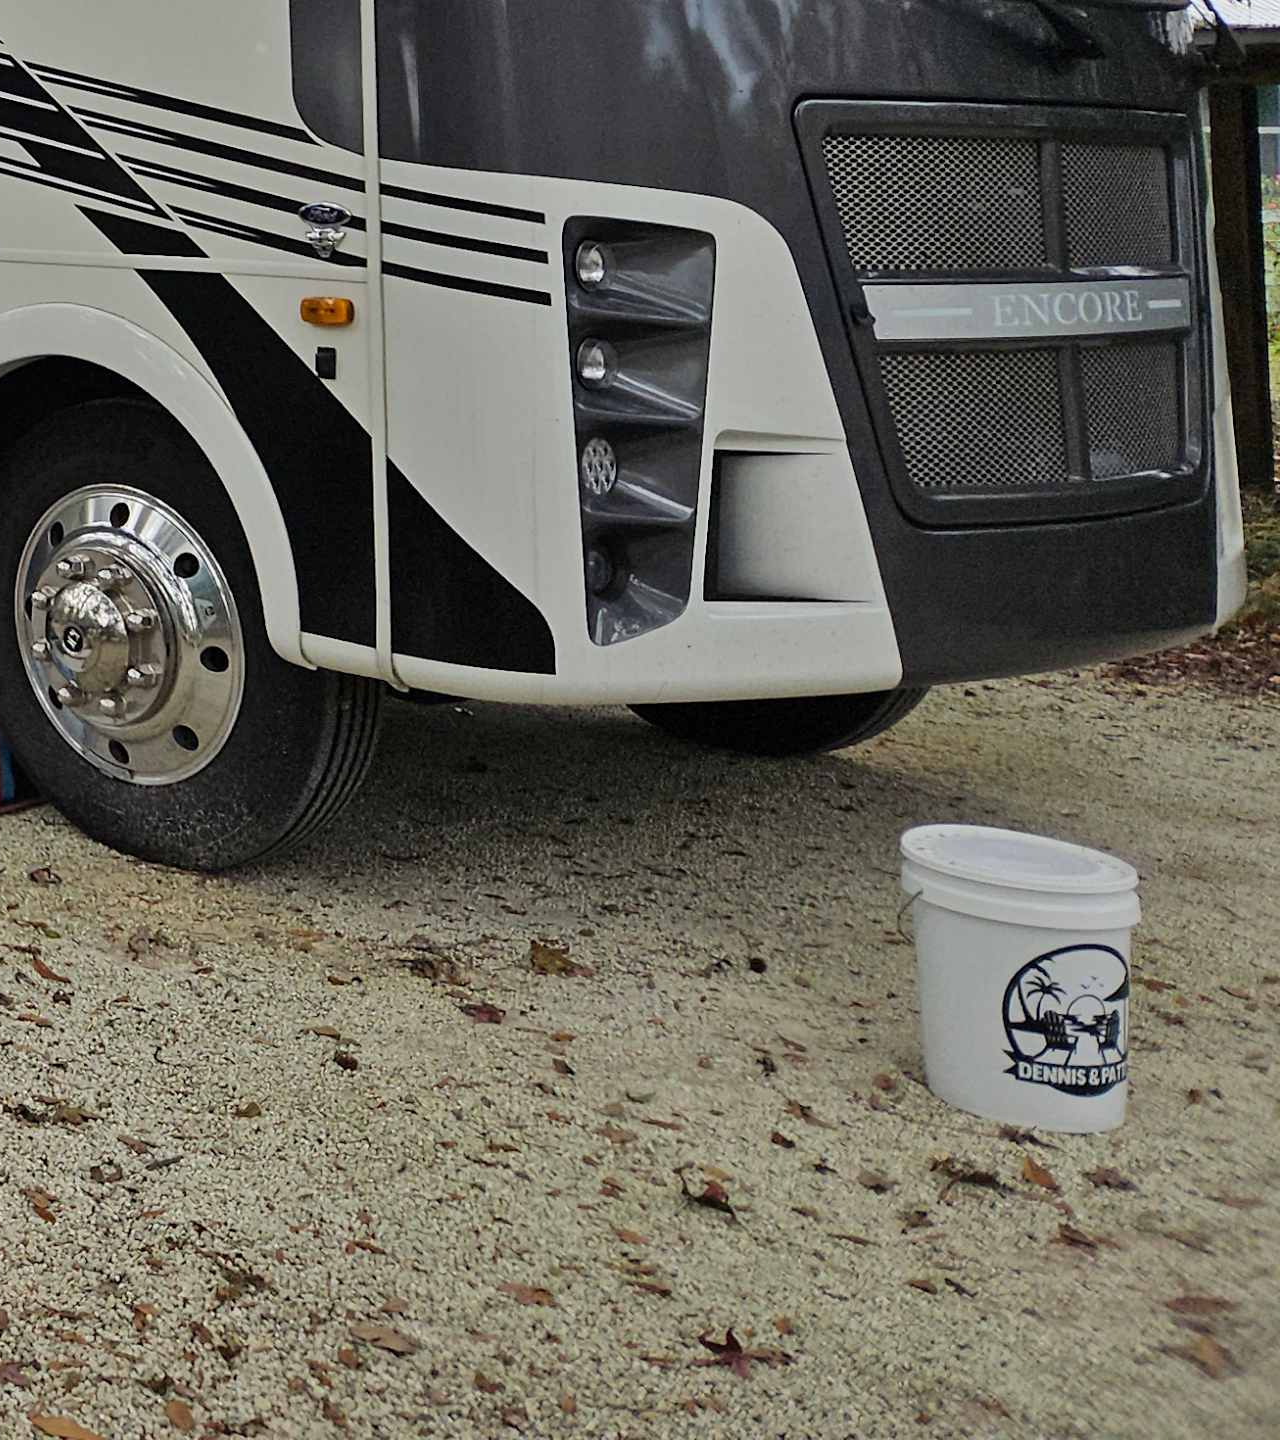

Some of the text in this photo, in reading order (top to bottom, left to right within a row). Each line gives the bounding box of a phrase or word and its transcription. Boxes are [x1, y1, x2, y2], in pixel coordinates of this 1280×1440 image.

[992, 290, 1143, 327] ENCORE
[1018, 1060, 1087, 1086] DENNIS
[1089, 1067, 1100, 1086] &
